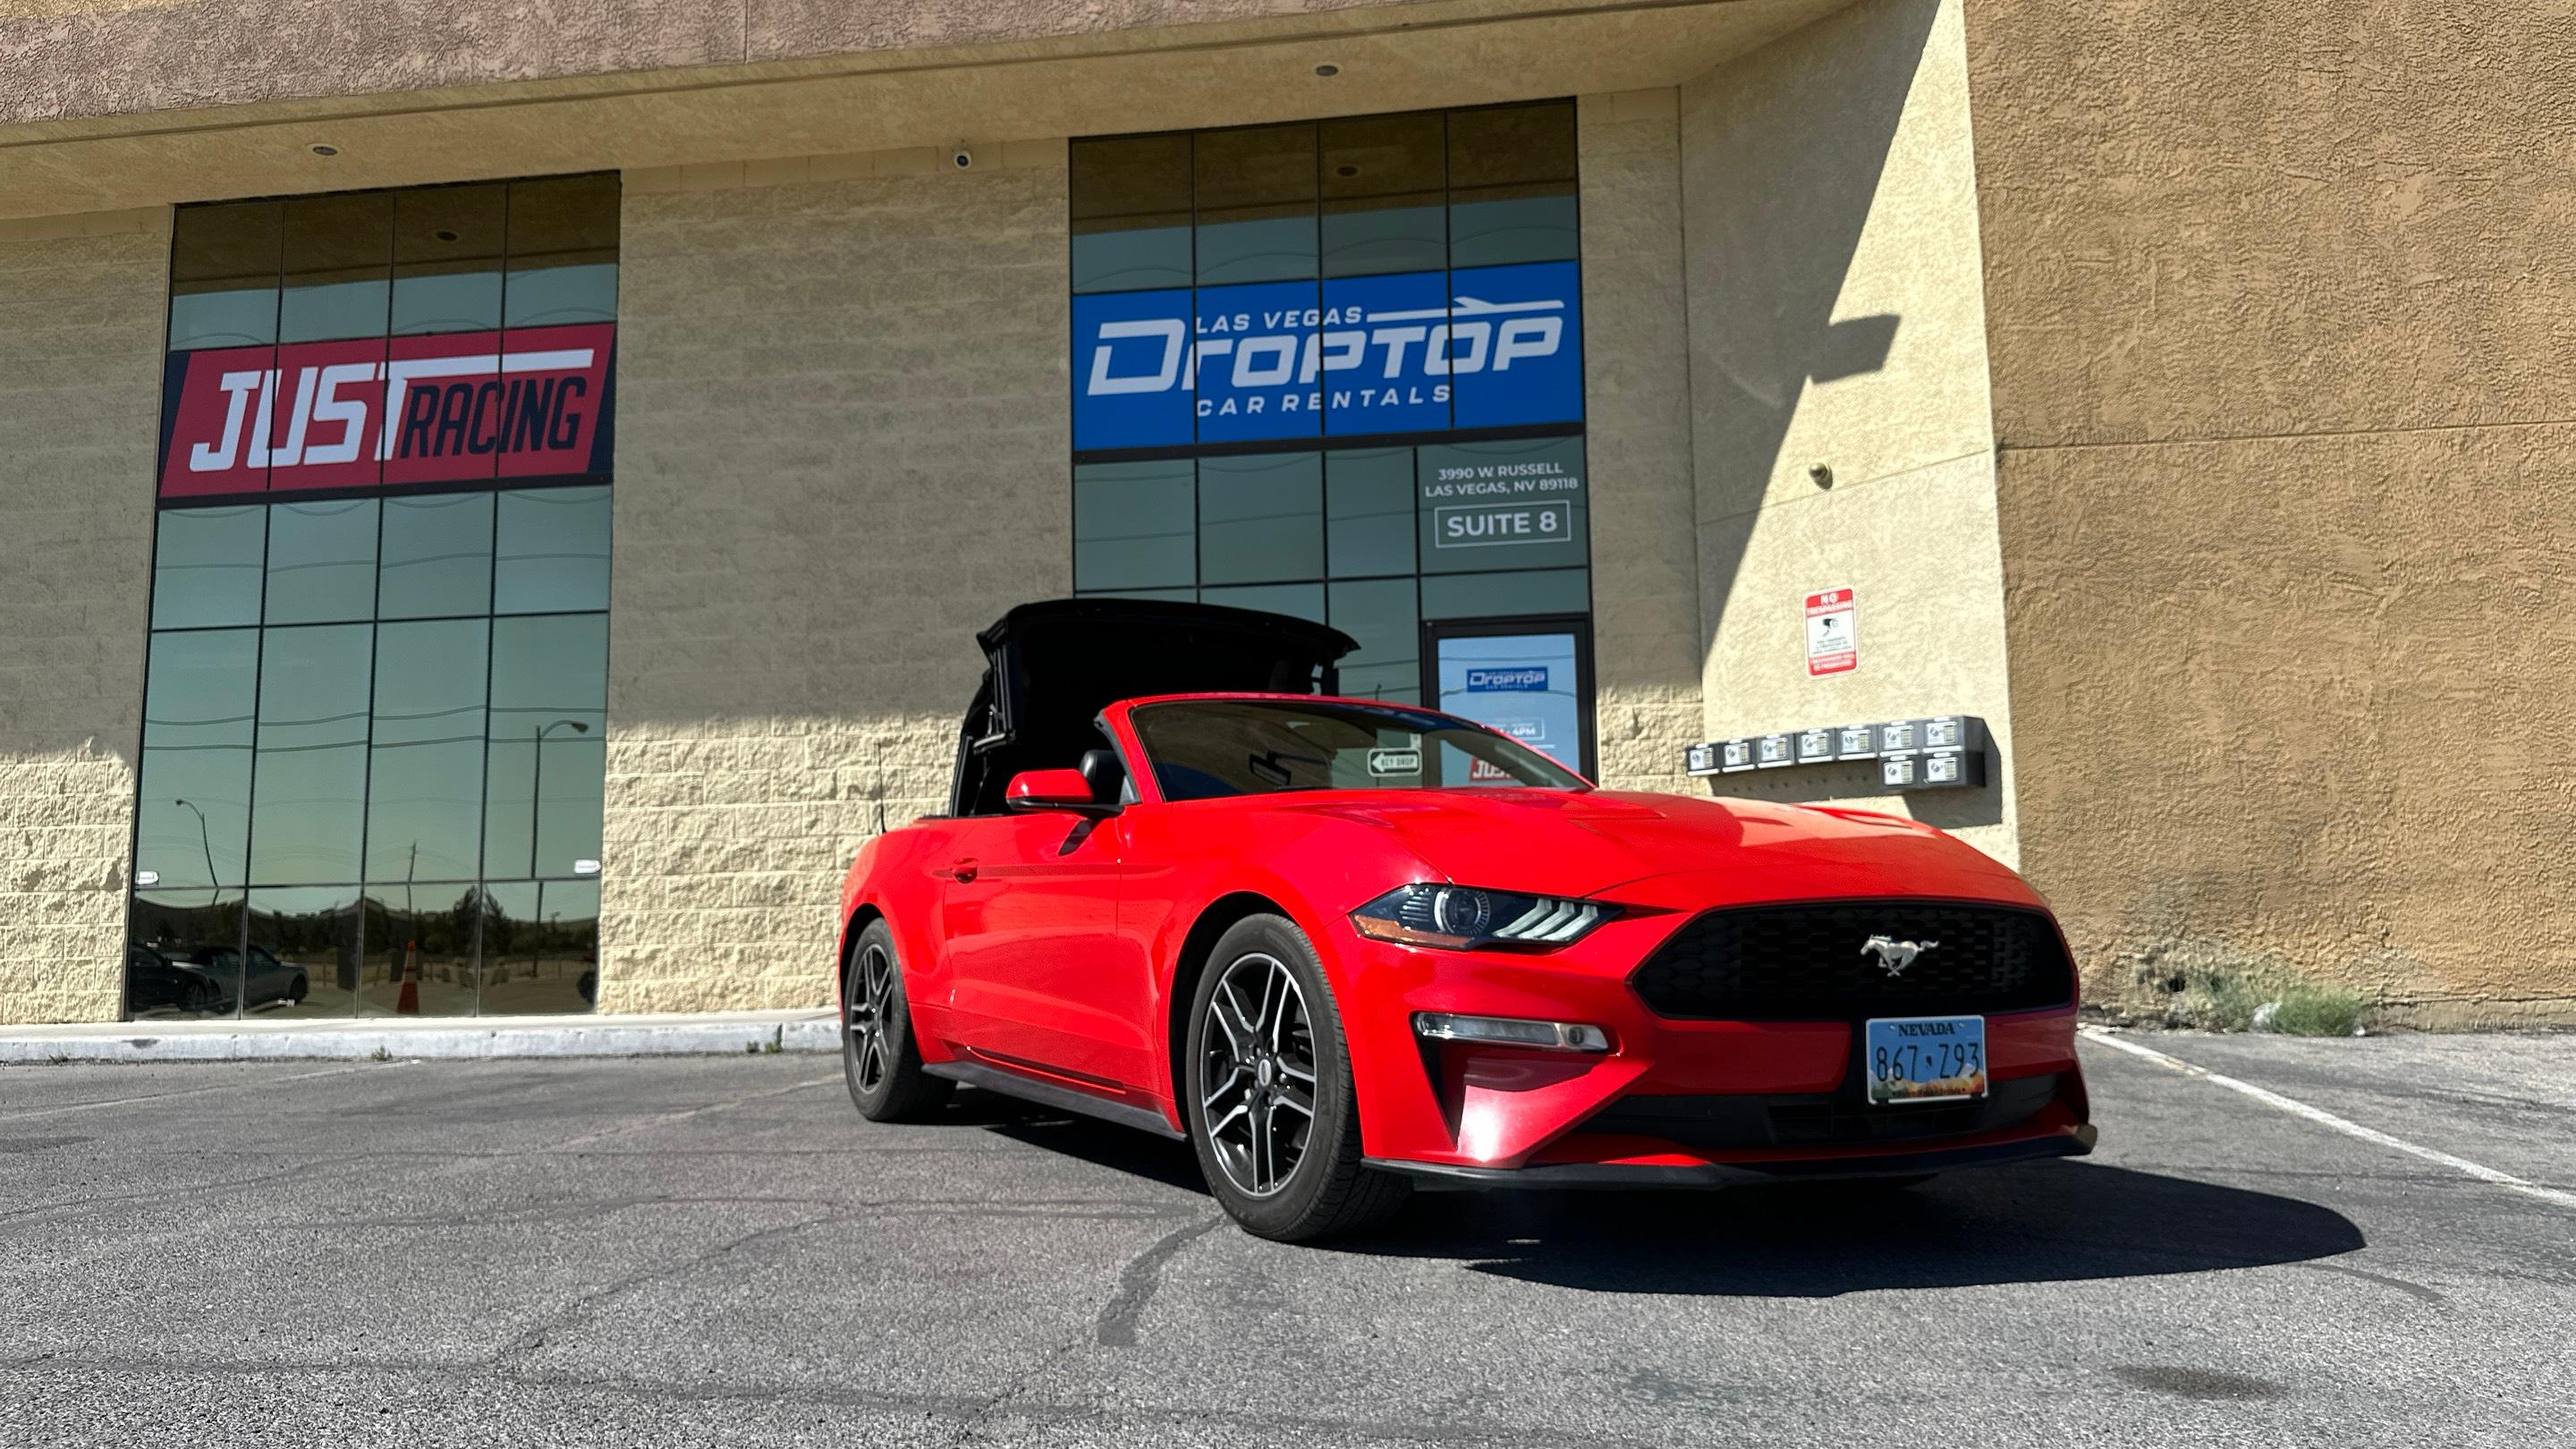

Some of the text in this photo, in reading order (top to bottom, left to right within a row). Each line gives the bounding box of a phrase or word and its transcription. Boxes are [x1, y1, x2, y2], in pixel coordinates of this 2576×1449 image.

[1197, 306, 1363, 334] LAS VEGAS
[190, 349, 595, 472] JUST
[1197, 385, 1452, 418] CAR RENTALS
[399, 374, 588, 460] RACING
[1438, 468, 1474, 481] 3990
[1497, 462, 1563, 477] RUSSELL
[1425, 477, 1579, 497] LAS VEGAS, NV 89118
[1447, 511, 1557, 538] SUITE 8
[1819, 592, 1838, 606] NO
[1898, 1022, 1955, 1038] NEVADA
